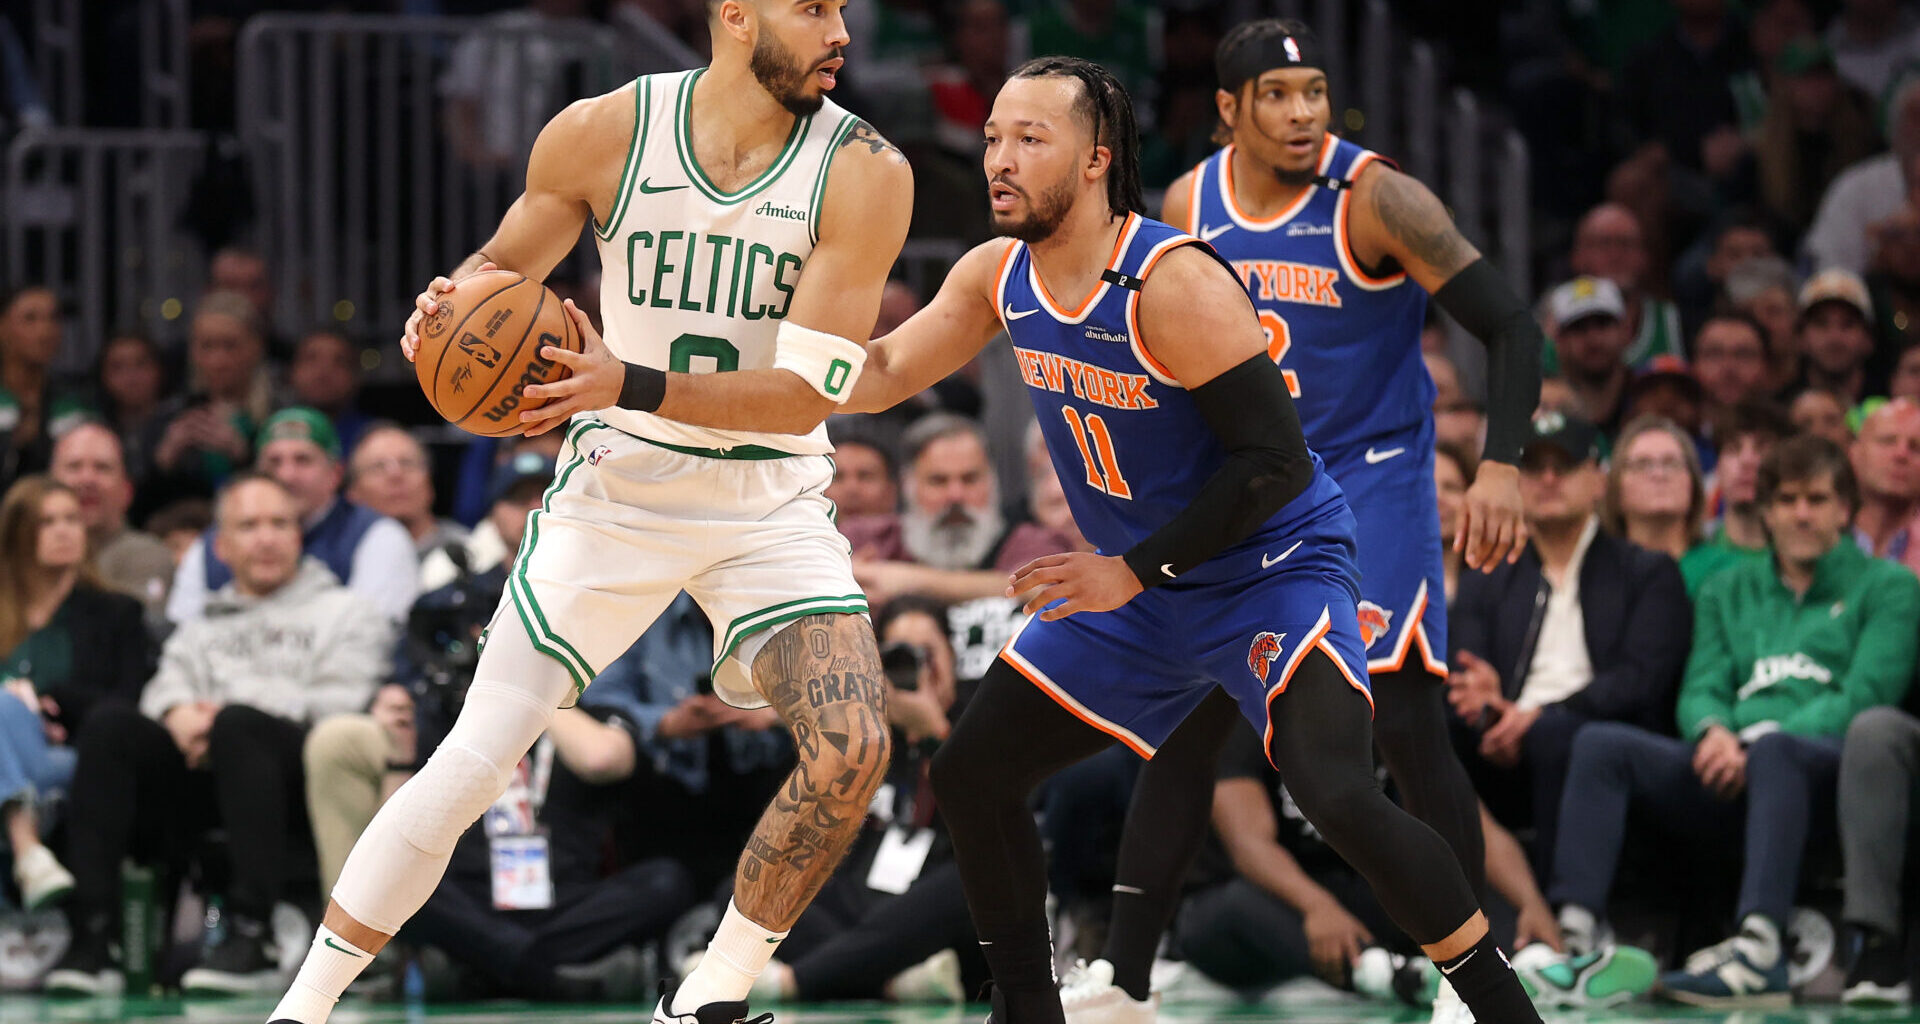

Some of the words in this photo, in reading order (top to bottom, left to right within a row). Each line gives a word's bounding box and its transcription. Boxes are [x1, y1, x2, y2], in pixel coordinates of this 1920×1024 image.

[756, 201, 807, 221] Amica
[627, 230, 803, 320] CELTICS
[1257, 260, 1343, 308] YORK
[823, 358, 852, 396] 0
[1012, 345, 1065, 394] NEW
[1063, 359, 1160, 411] YORK
[1061, 404, 1133, 500] 11
